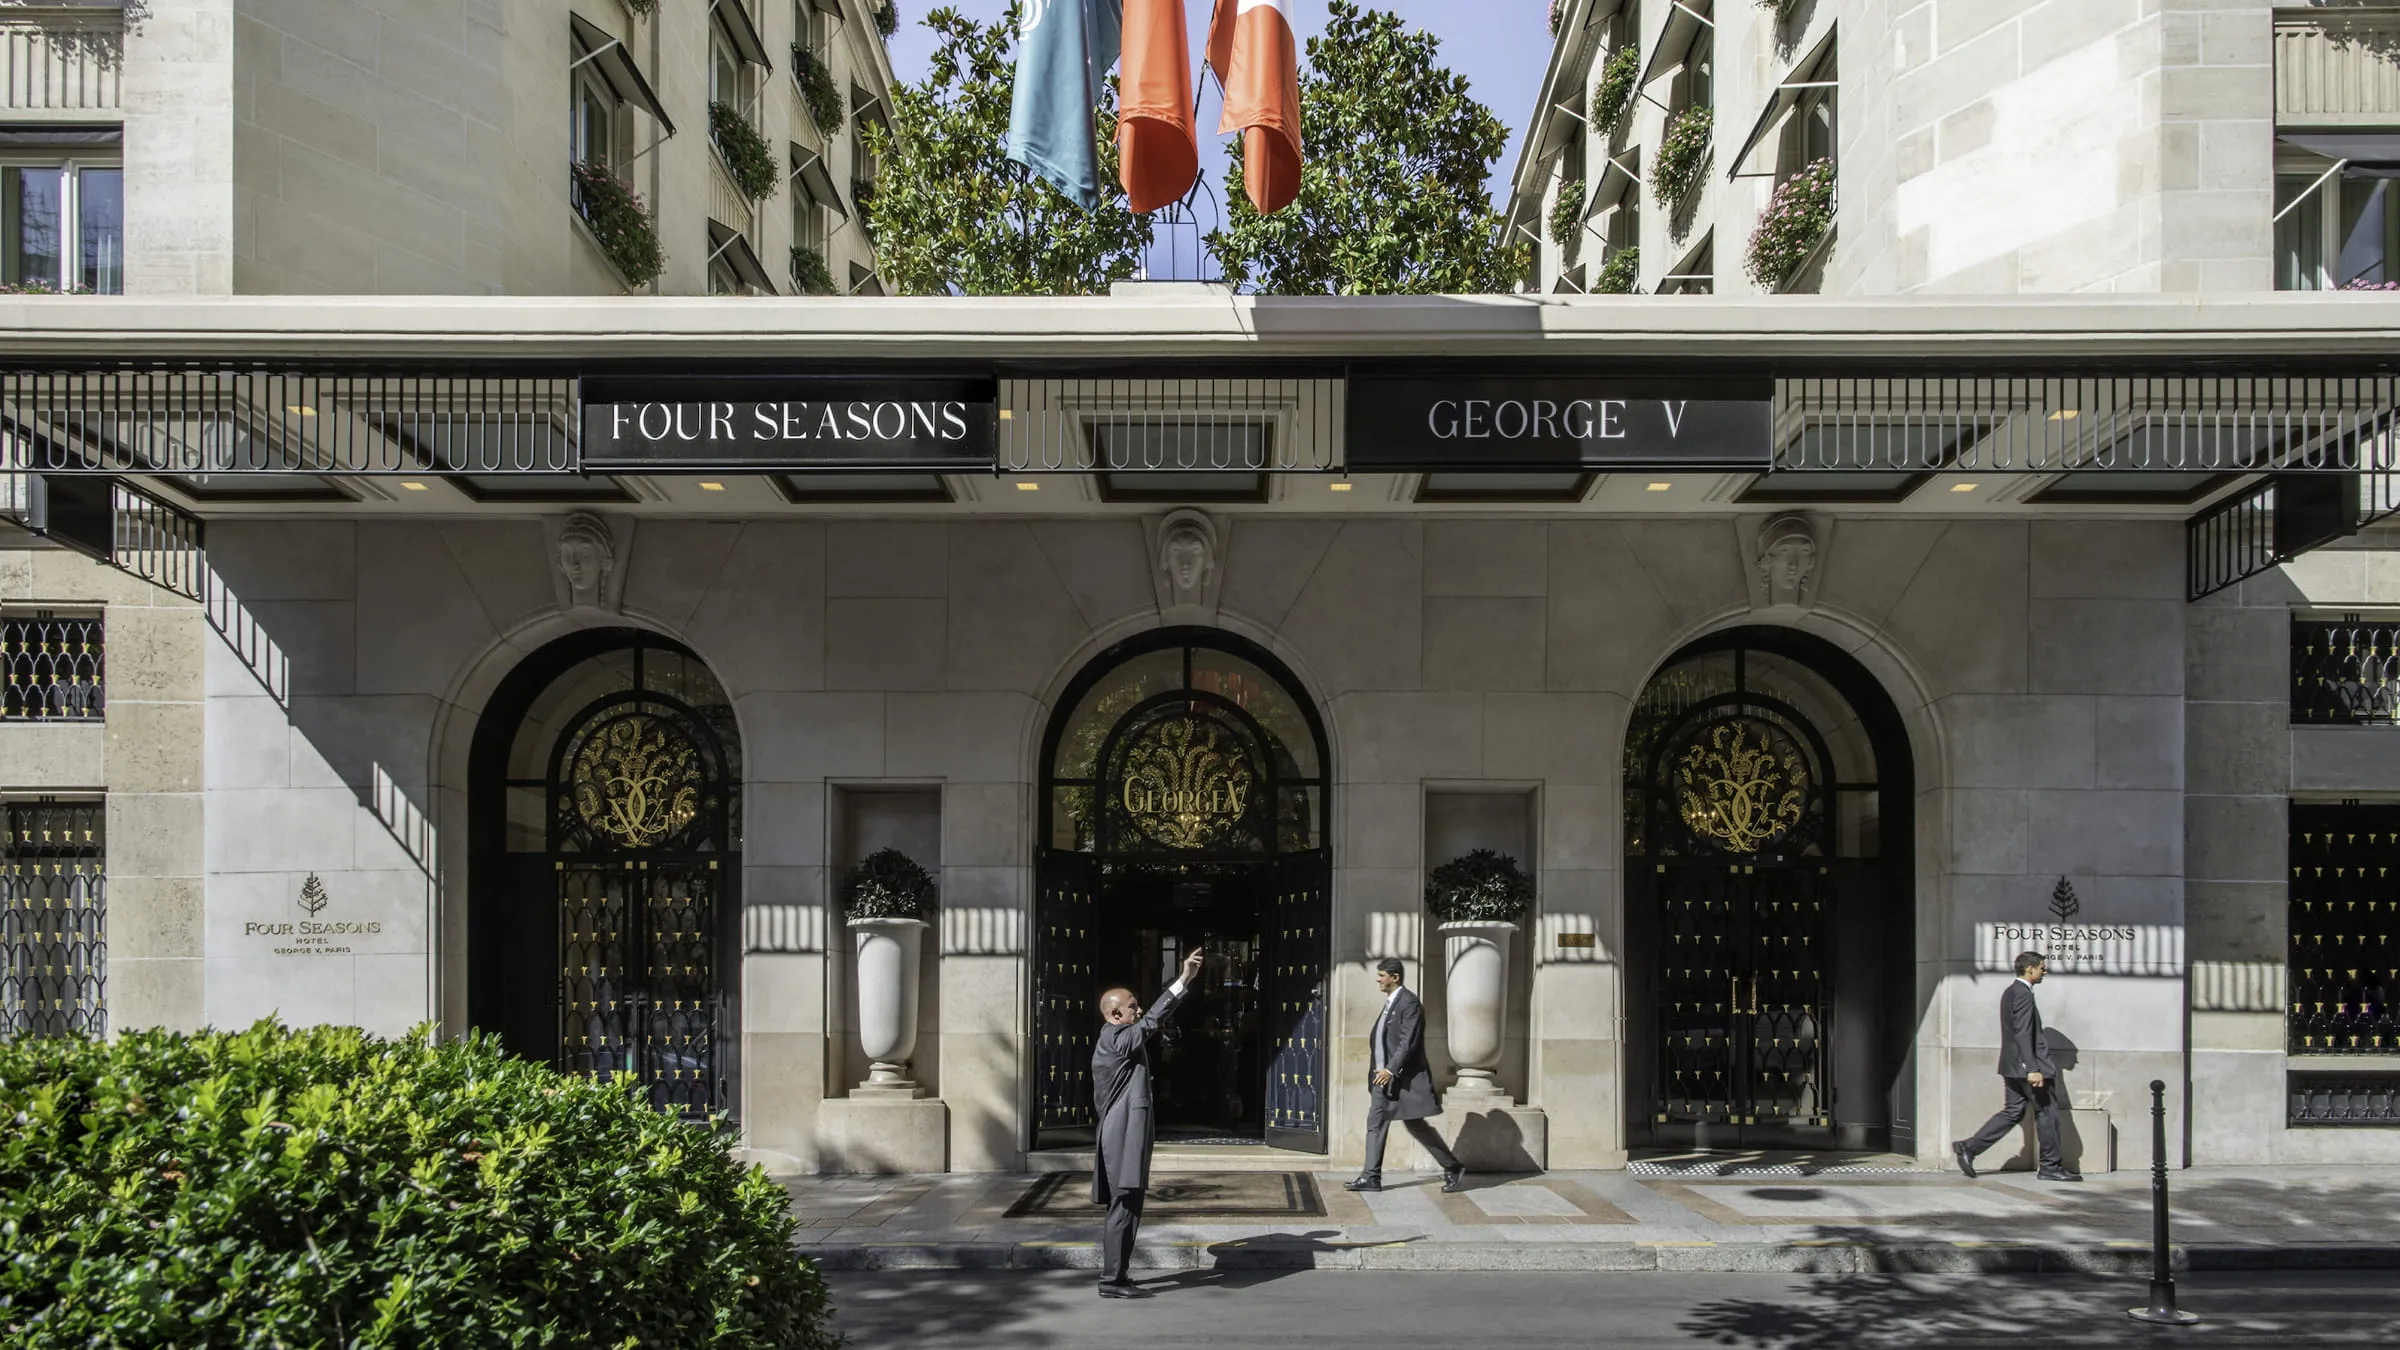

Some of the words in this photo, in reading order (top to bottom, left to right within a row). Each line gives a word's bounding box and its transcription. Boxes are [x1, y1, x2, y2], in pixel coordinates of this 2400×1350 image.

[611, 401, 737, 440] FOUR
[753, 401, 968, 440] SEASONS
[1427, 400, 1627, 439] GEORGE
[1660, 400, 1688, 439] V
[244, 922, 294, 936] FOUR
[299, 921, 381, 935] SEASONS
[1993, 926, 2044, 940] FOUR
[2050, 926, 2135, 941] SEASONS
[295, 937, 329, 945] HOTEL
[273, 947, 312, 955] GEORGE
[325, 946, 351, 954] PARIS
[2077, 953, 2104, 961] PARIS
